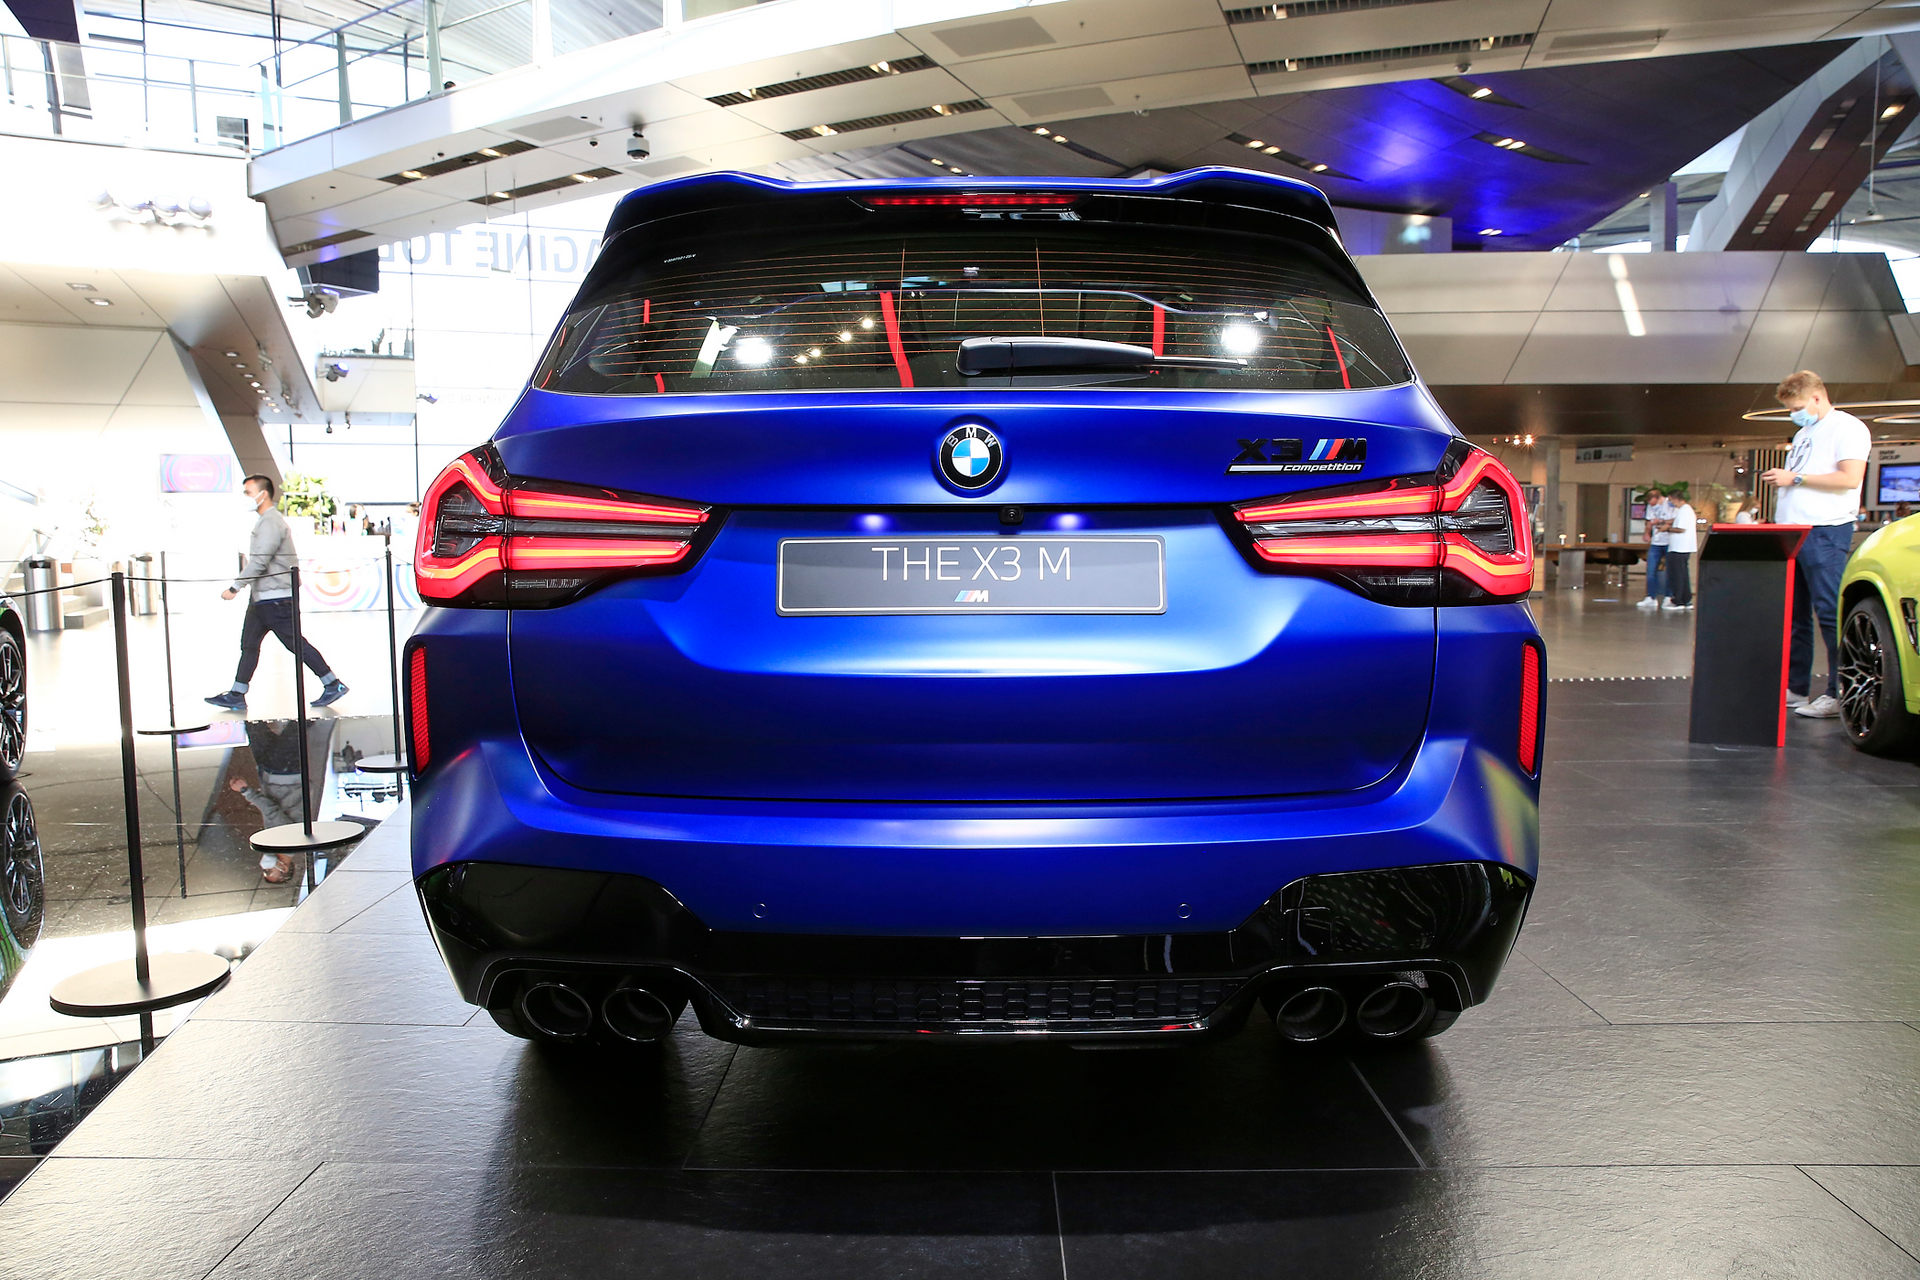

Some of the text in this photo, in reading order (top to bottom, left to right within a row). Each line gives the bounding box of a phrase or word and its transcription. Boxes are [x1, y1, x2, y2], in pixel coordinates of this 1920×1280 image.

[946, 426, 997, 448] BMW
[1232, 437, 1303, 462] X3
[1282, 462, 1362, 473] competition
[871, 546, 1071, 581] THE X3 M
